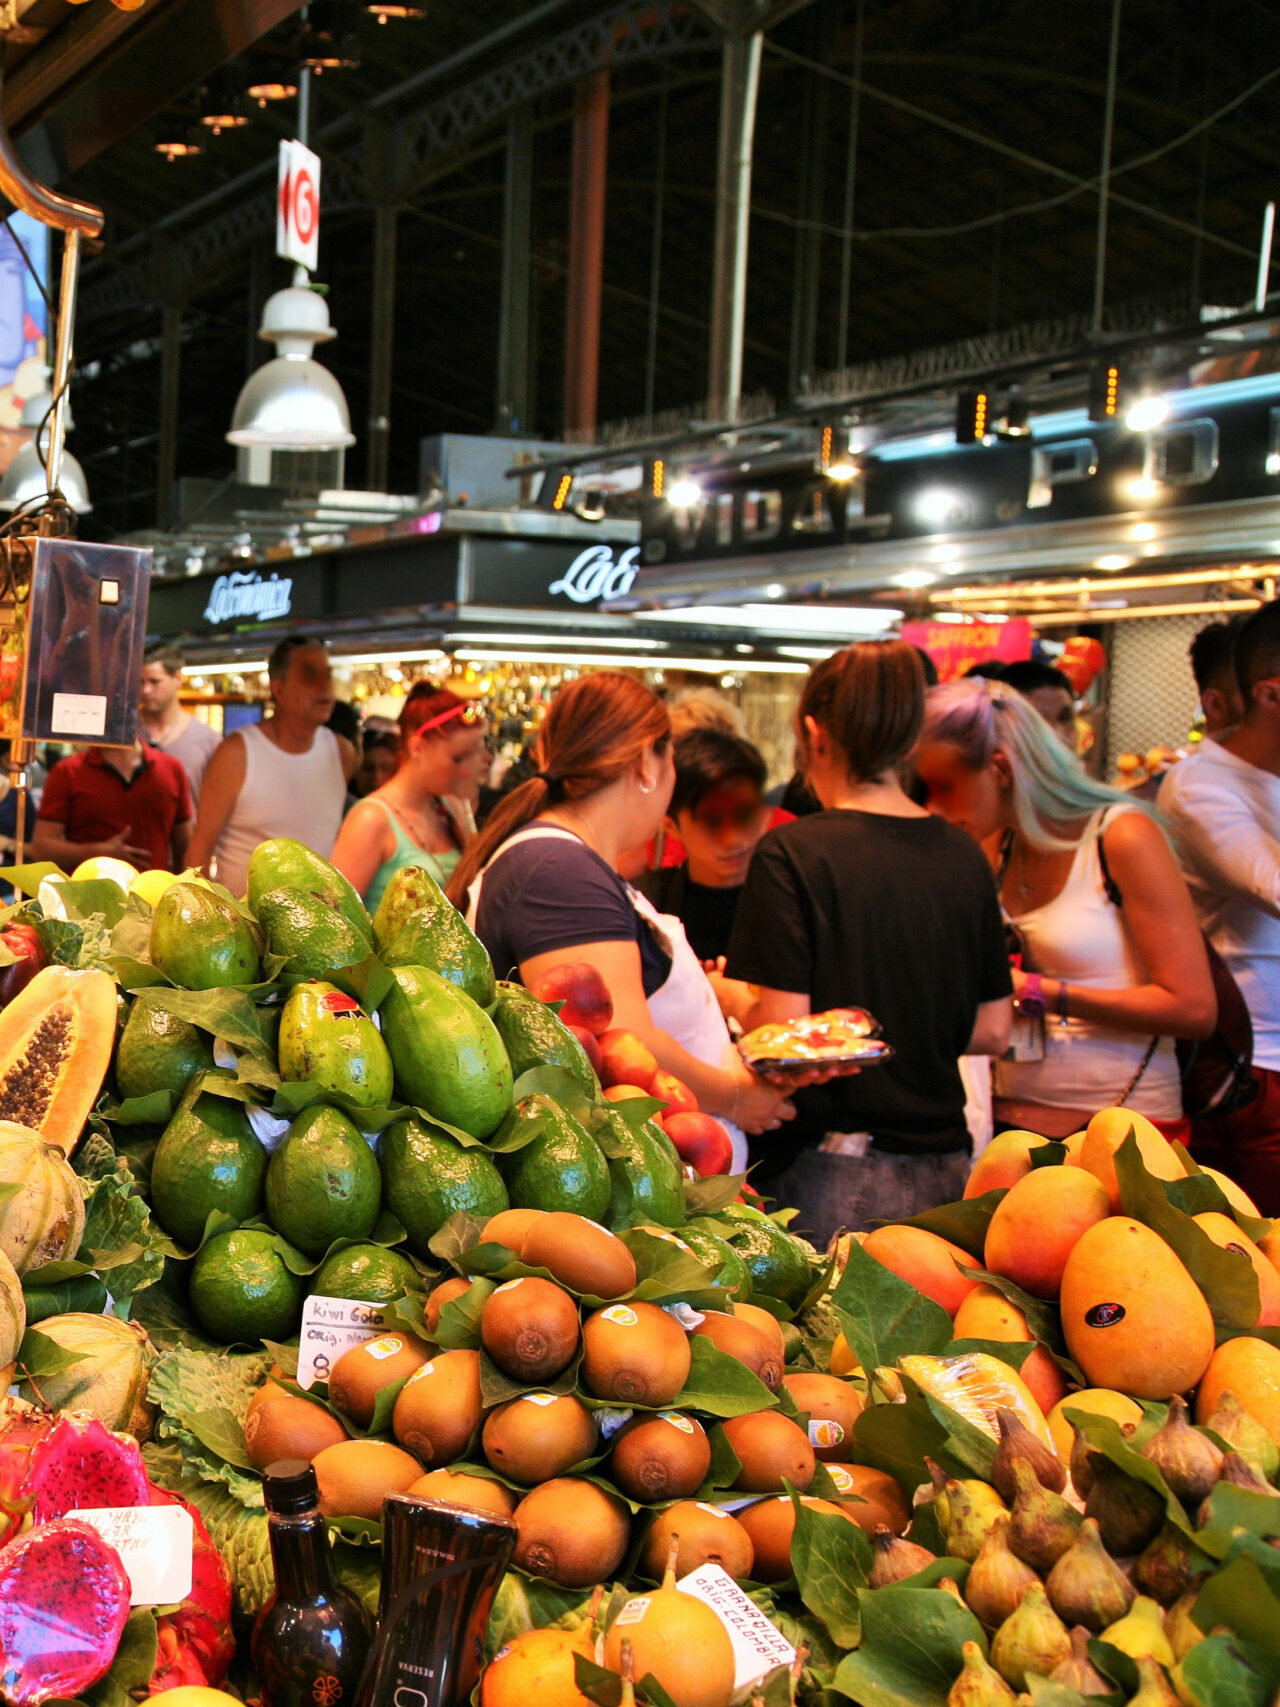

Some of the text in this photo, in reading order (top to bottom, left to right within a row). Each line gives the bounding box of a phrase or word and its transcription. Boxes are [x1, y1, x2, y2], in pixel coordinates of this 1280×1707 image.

[297, 180, 313, 234] 6
[313, 1353, 330, 1379] 8
[714, 1577, 790, 1653] GRANADILLA
[398, 1660, 435, 1679] RESERVA
